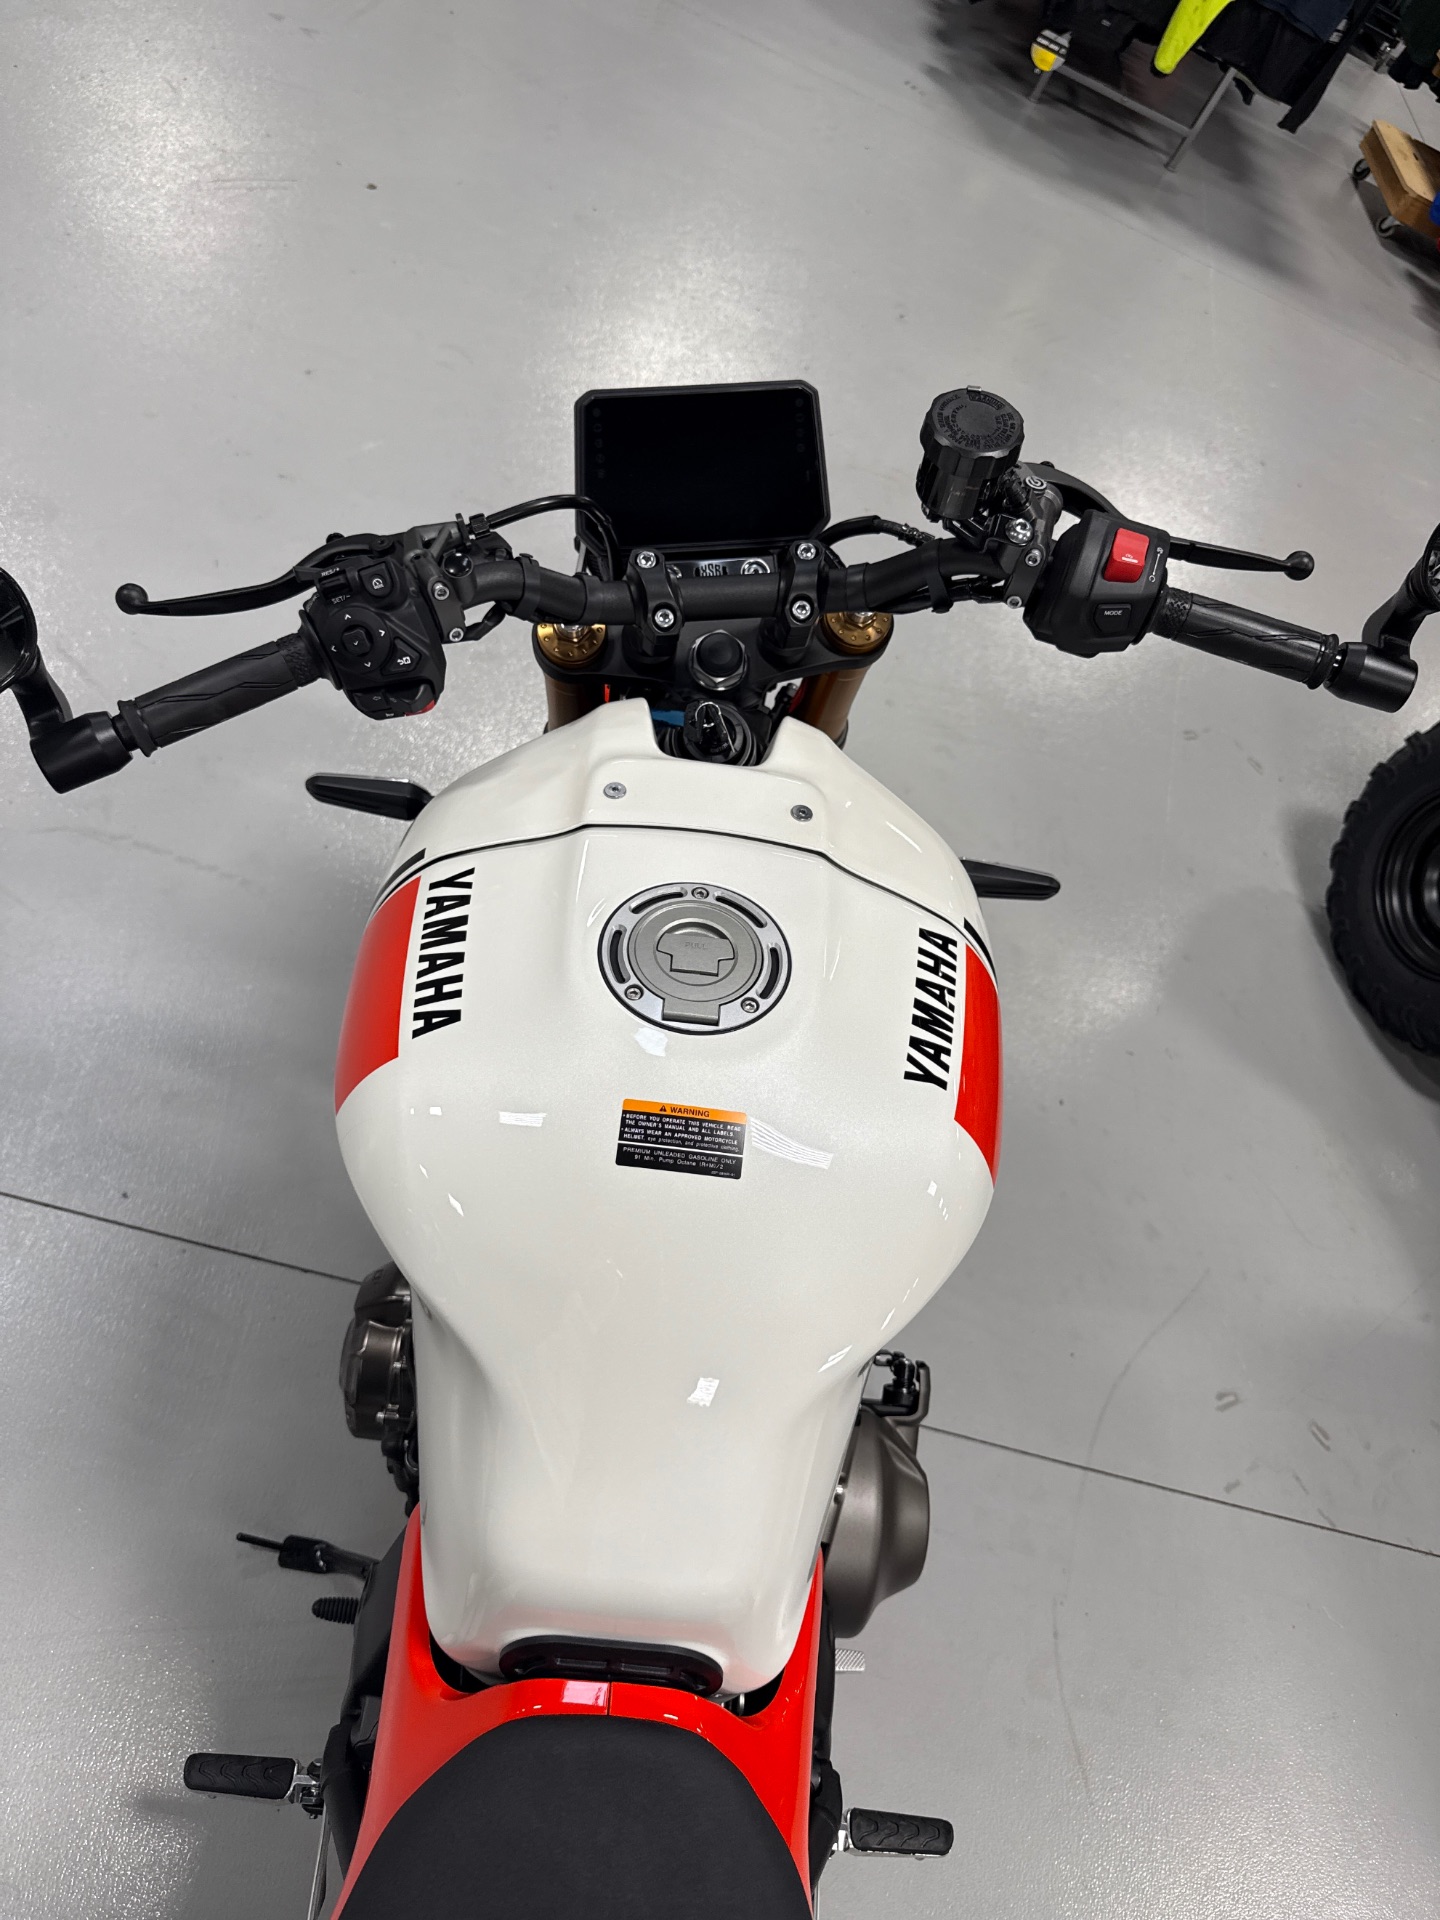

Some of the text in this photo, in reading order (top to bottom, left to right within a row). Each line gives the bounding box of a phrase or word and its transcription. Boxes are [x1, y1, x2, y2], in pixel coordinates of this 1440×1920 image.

[412, 867, 475, 1039] YAMAHA
[903, 927, 957, 1091] YAMAHA
[670, 1106, 709, 1117] WARNING
[638, 1120, 661, 1128] OWNER'S
[673, 1132, 701, 1140] APPROVED
[704, 1135, 737, 1144] MOTORCYCLE
[622, 1146, 650, 1154] PREMIUM
[653, 1149, 685, 1158] UNLEADED
[688, 1153, 718, 1162] GASOLINE
[658, 1156, 674, 1164] Pump
[676, 1158, 696, 1166] Octane
